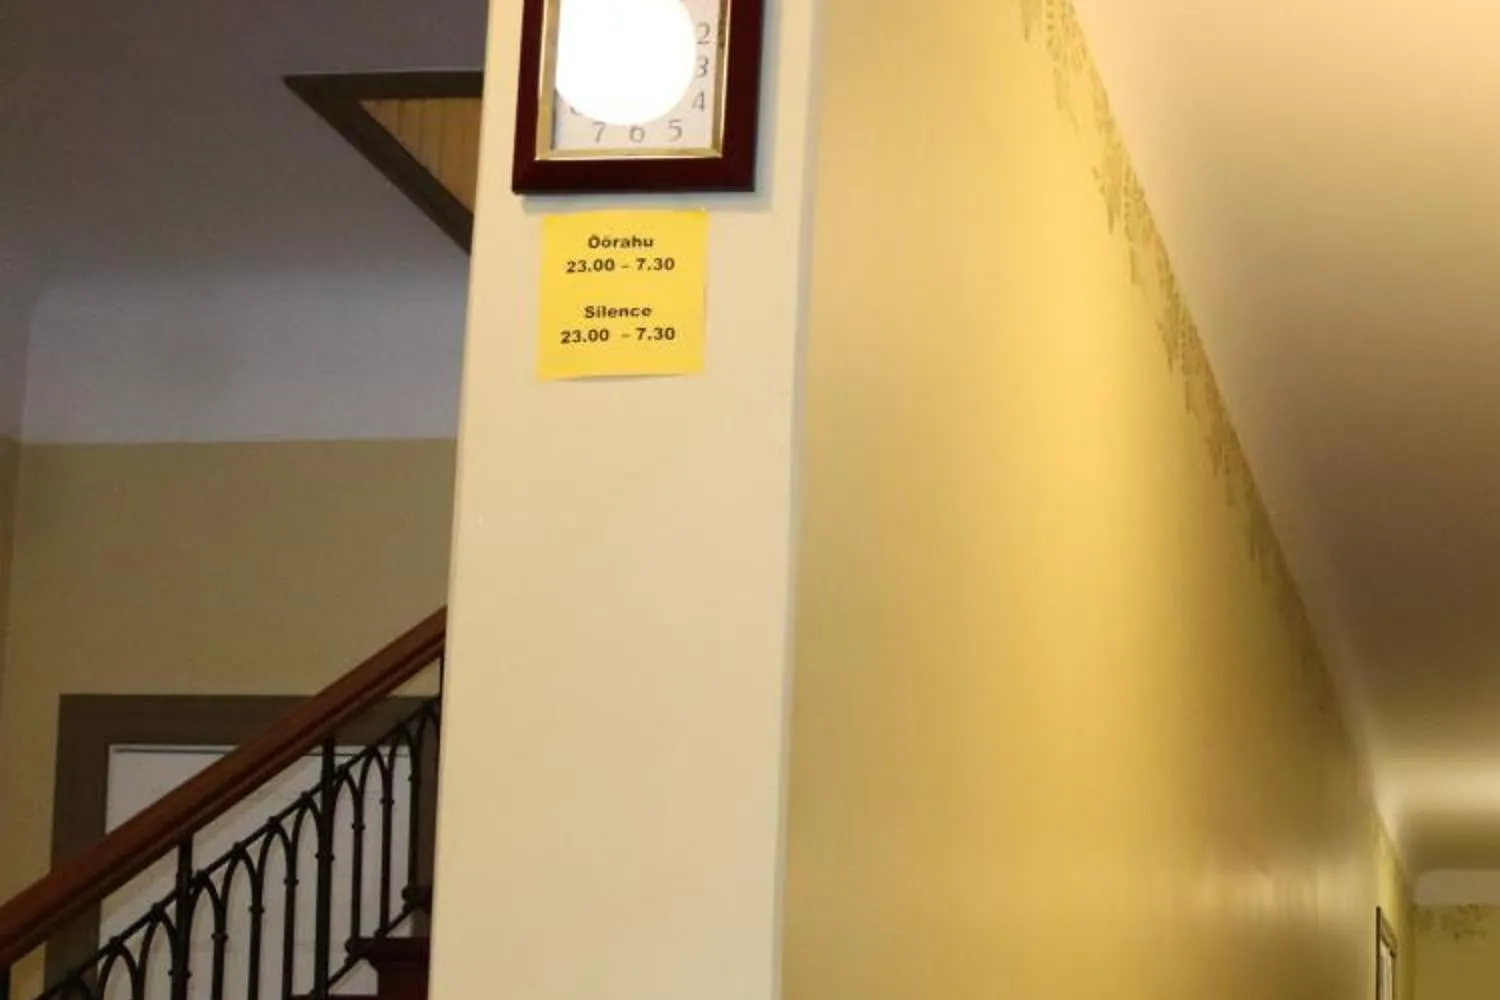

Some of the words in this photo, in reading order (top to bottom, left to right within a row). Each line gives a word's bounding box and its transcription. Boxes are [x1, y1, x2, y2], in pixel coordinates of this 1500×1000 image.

[696, 22, 710, 45] 2
[695, 57, 709, 78] 3
[692, 90, 706, 112] 4
[592, 121, 606, 143] 7
[668, 119, 683, 141] 5
[566, 258, 615, 274] 23.00
[636, 257, 675, 271] 7.30
[584, 306, 652, 319] Silence
[560, 328, 609, 344] 23.00
[636, 327, 675, 341] 7.30
